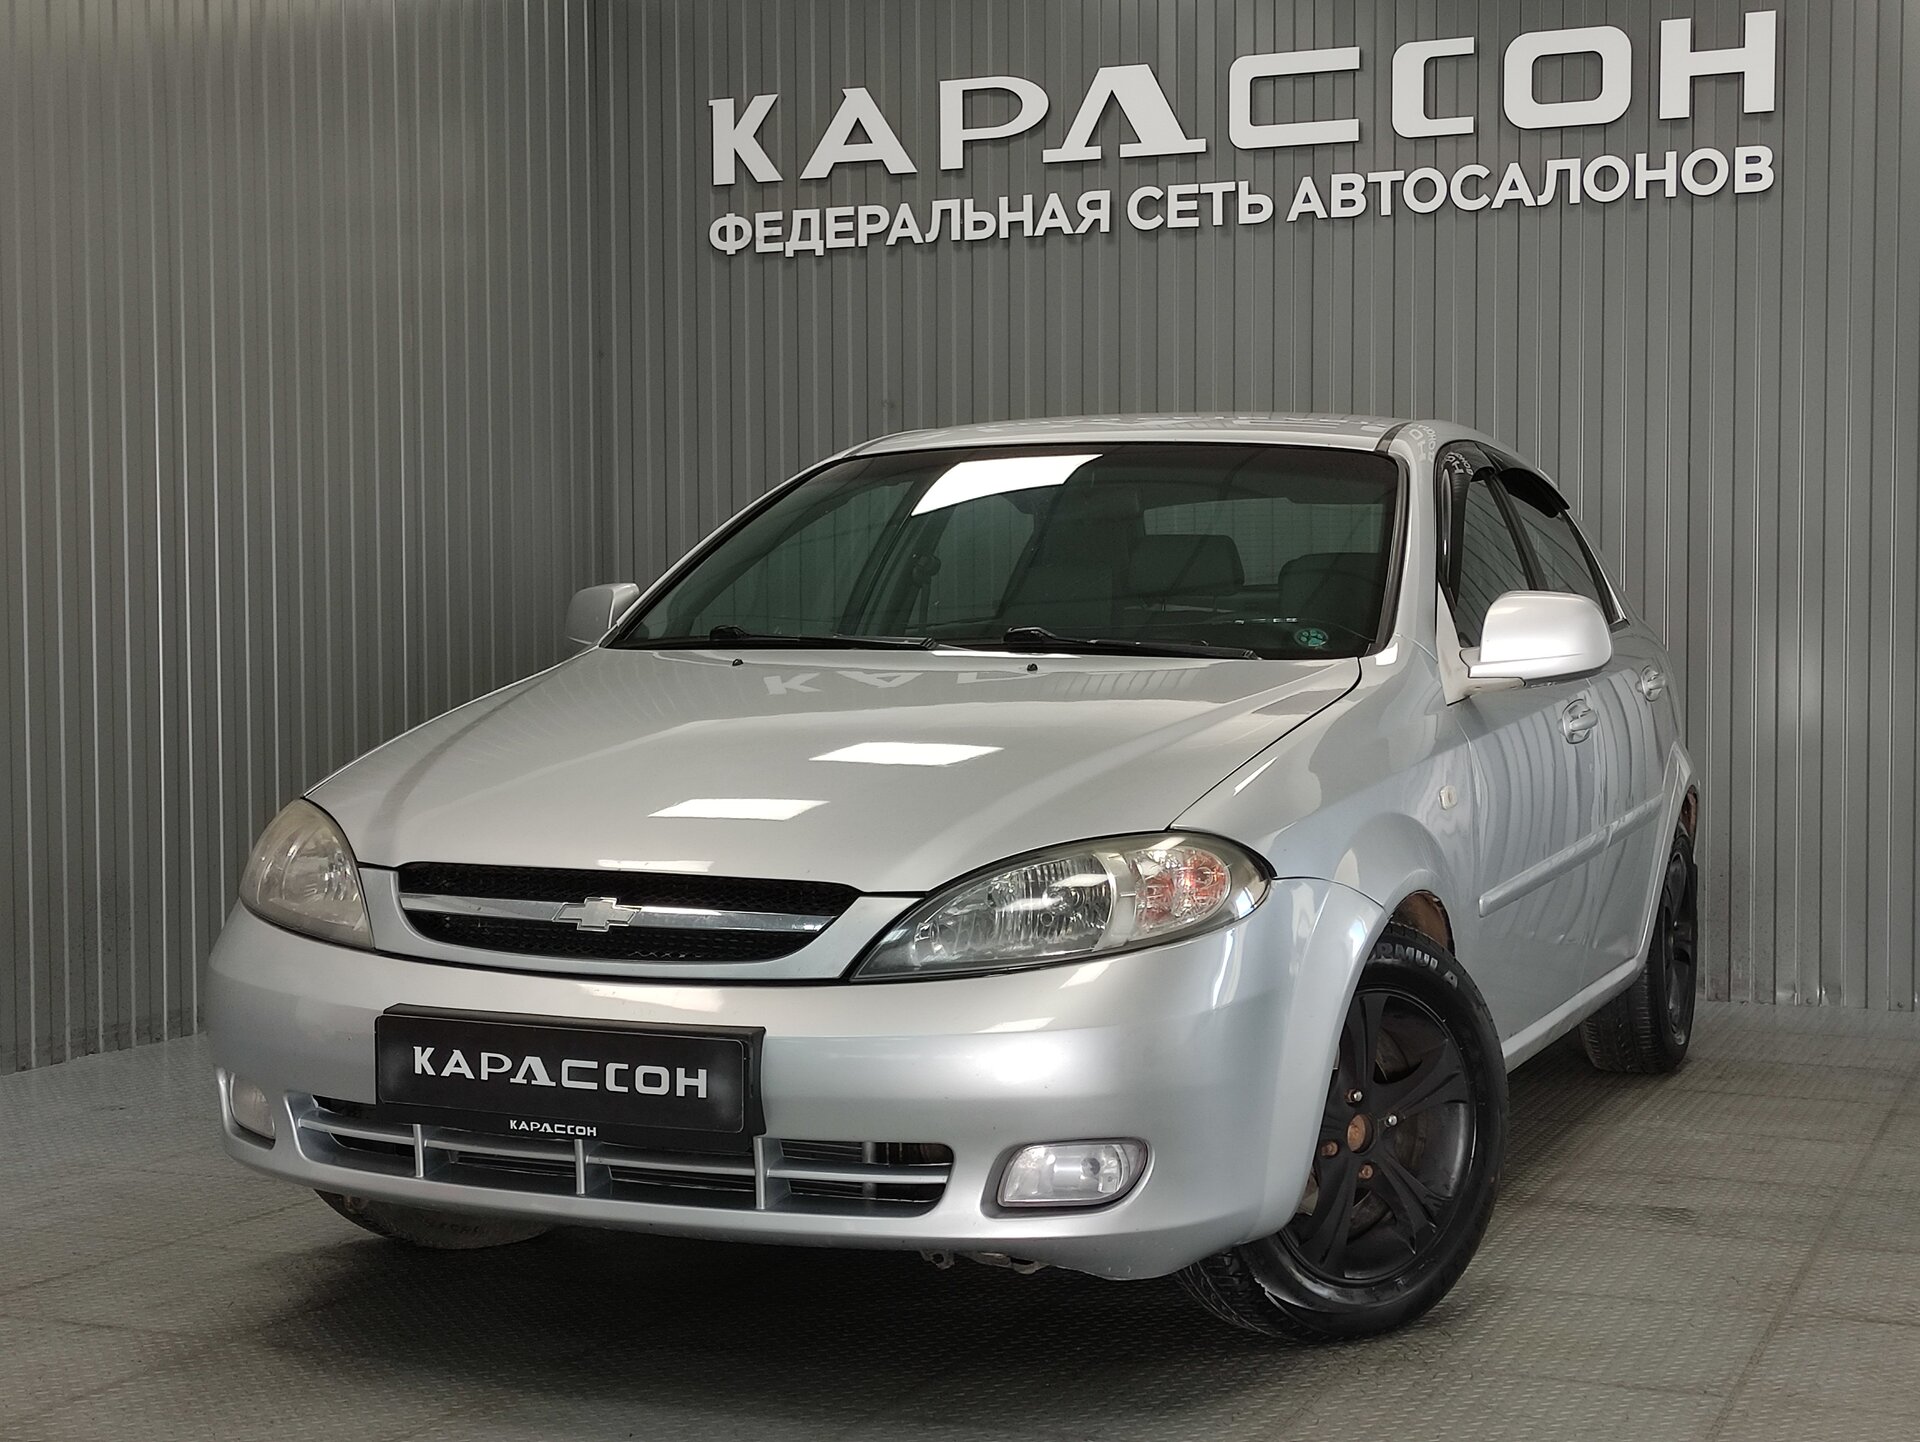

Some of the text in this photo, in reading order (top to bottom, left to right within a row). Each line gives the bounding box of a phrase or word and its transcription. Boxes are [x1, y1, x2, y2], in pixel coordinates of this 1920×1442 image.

[708, 145, 1776, 257] ФЕДЕРАЛЬНАЯ СЕТЬ АВТОСАЛОНОВ
